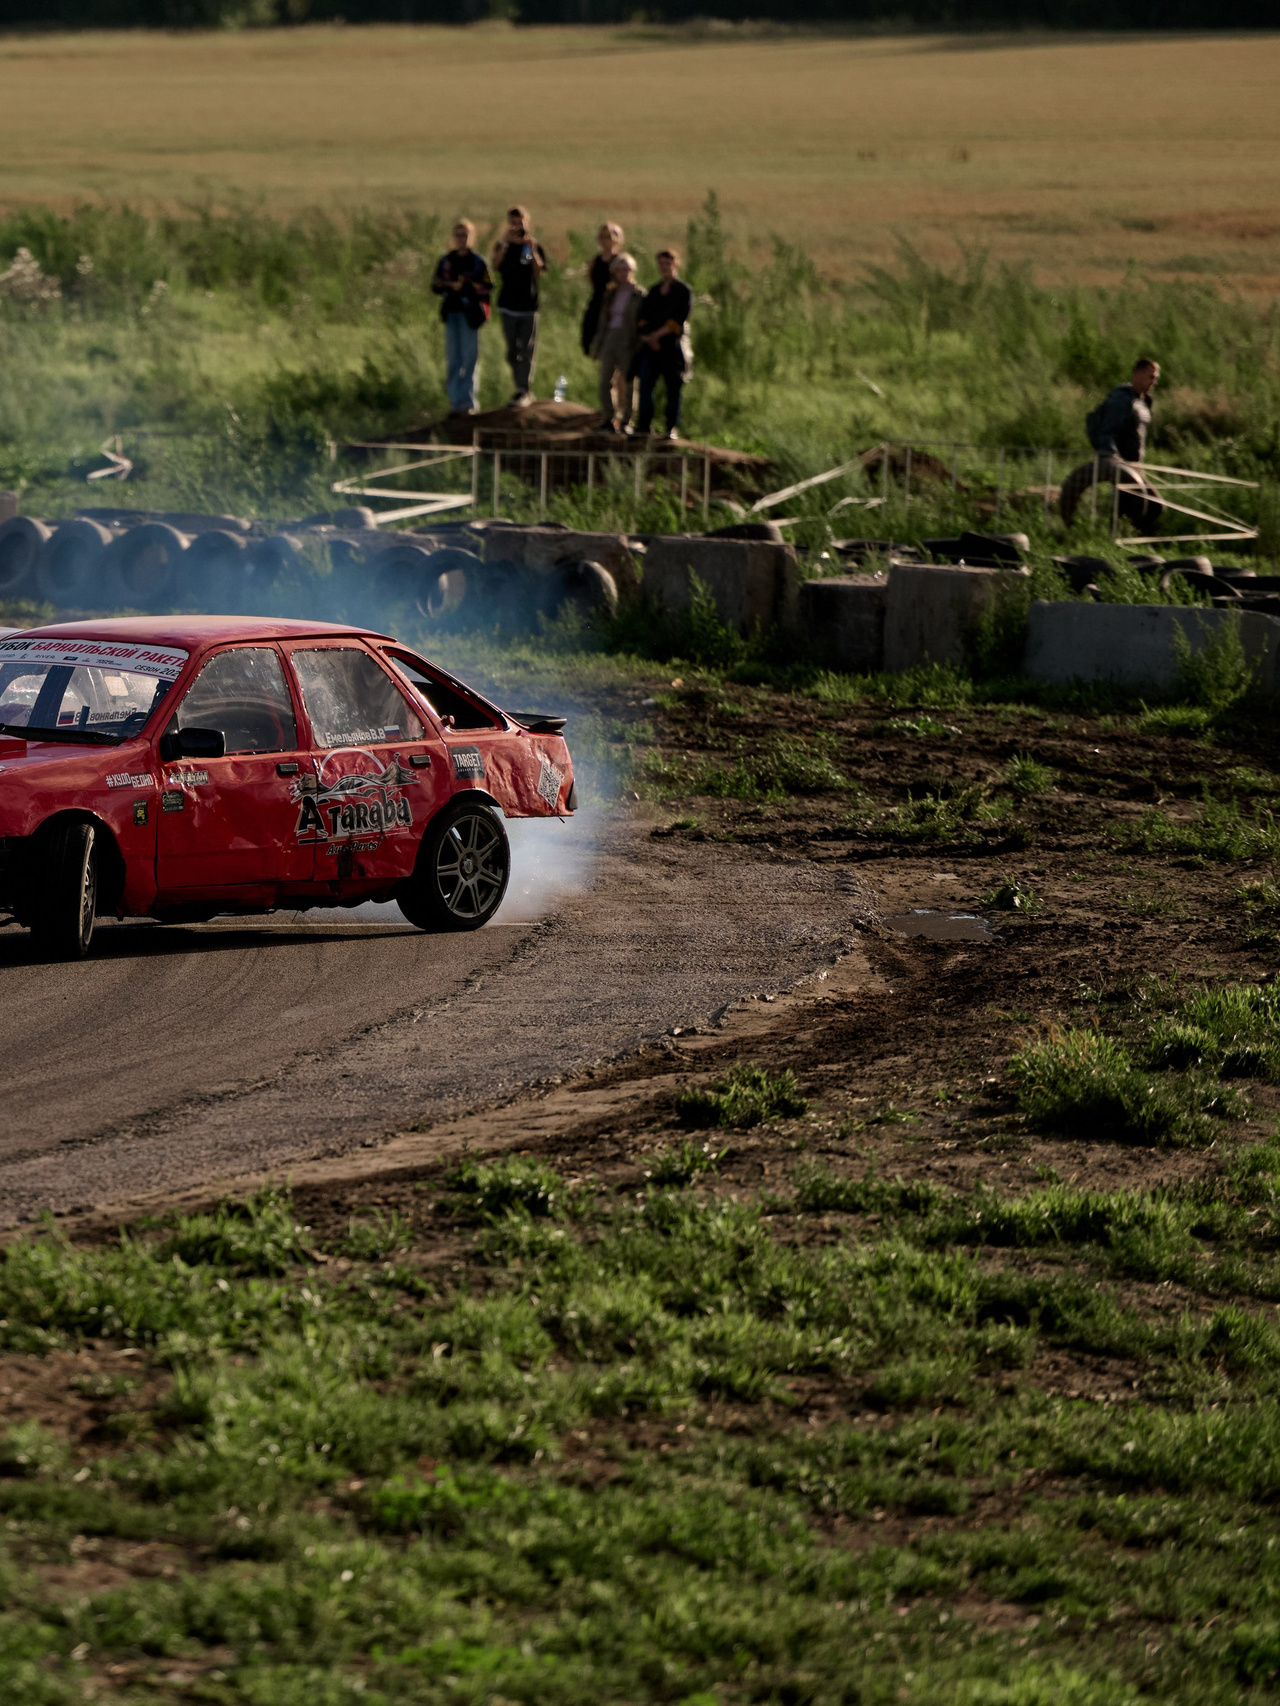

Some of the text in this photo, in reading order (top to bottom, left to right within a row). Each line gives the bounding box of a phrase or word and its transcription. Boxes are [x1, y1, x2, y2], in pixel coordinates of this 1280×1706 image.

[31, 641, 140, 659] БАРНАУЛЬСКОЙ
[134, 664, 181, 678] СЕЗОН 202
[325, 731, 372, 744] Емельянов
[452, 753, 481, 768] TARGET
